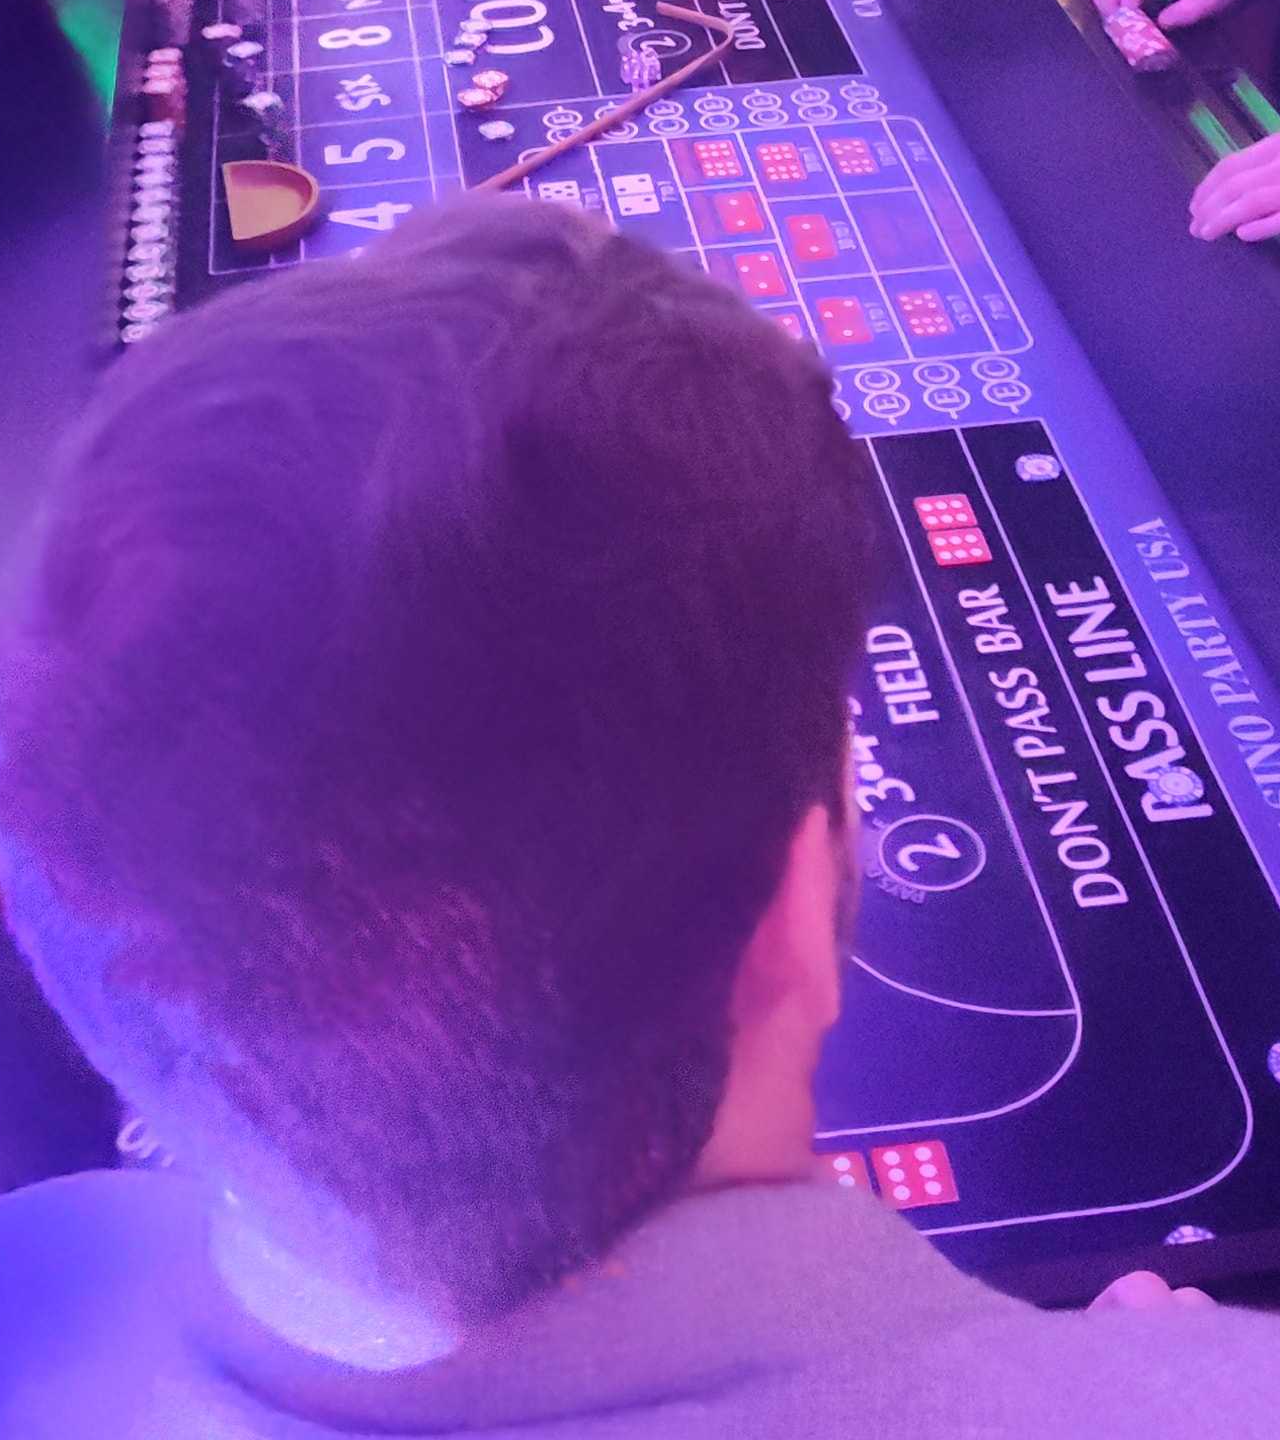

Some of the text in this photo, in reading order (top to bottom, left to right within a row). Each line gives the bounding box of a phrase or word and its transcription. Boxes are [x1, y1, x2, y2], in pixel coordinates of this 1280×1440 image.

[318, 24, 392, 50] 8
[323, 137, 407, 166] 5
[327, 201, 414, 232] 4
[1127, 517, 1190, 583] USA
[866, 625, 941, 725] FIELD
[1160, 591, 1260, 706] PARTY
[1044, 576, 1213, 823] PASS LINE
[958, 583, 1130, 909] DON'T PASS BAR
[897, 833, 962, 873] 2
